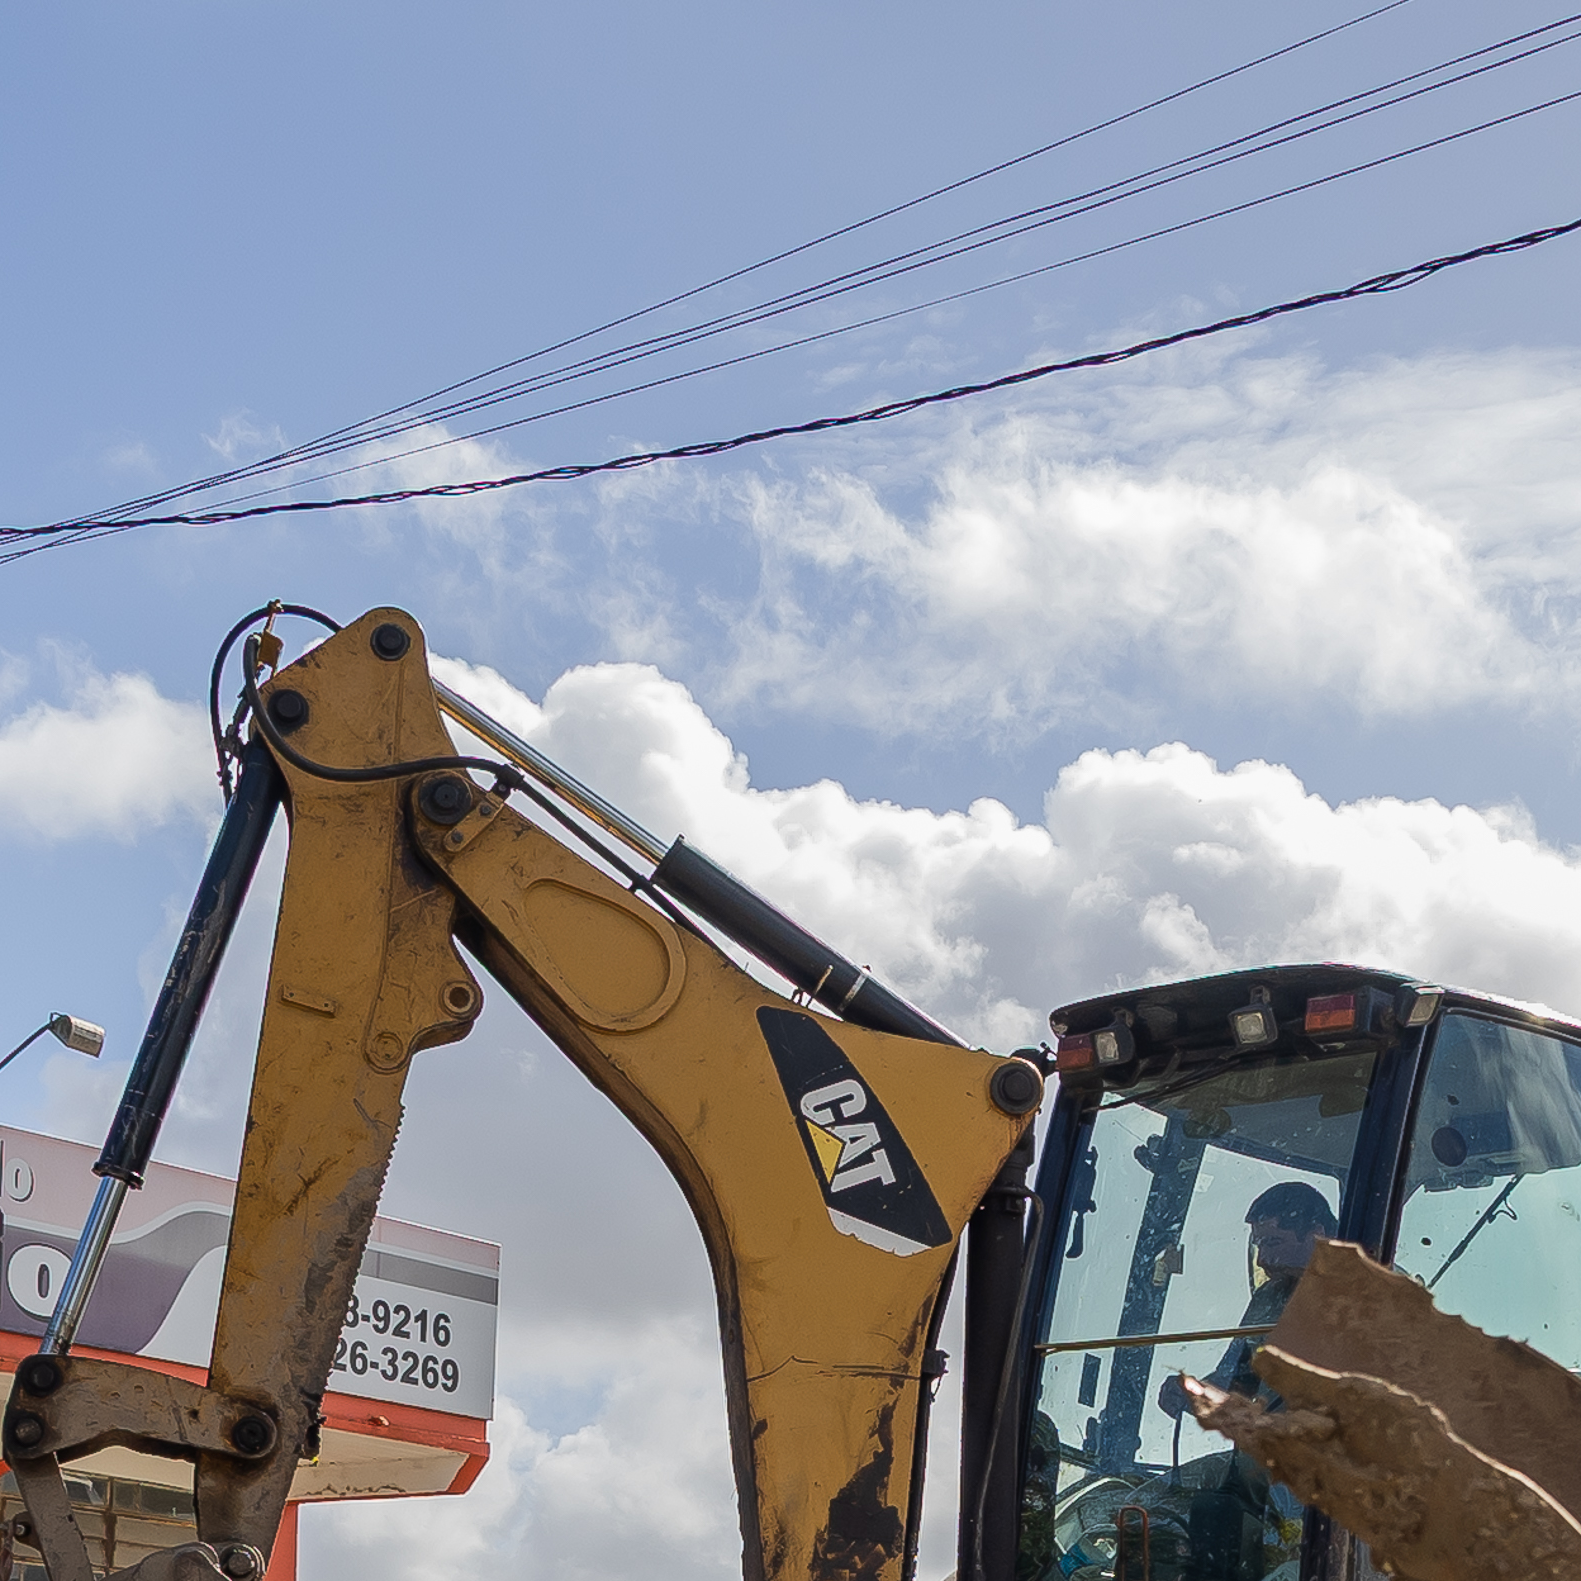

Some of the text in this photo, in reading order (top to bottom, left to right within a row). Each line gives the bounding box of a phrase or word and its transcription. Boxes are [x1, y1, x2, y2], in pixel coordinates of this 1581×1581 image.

[800, 1078, 897, 1193] CAT
[345, 1294, 452, 1348] 8-9216
[332, 1337, 460, 1393] 26-3269
